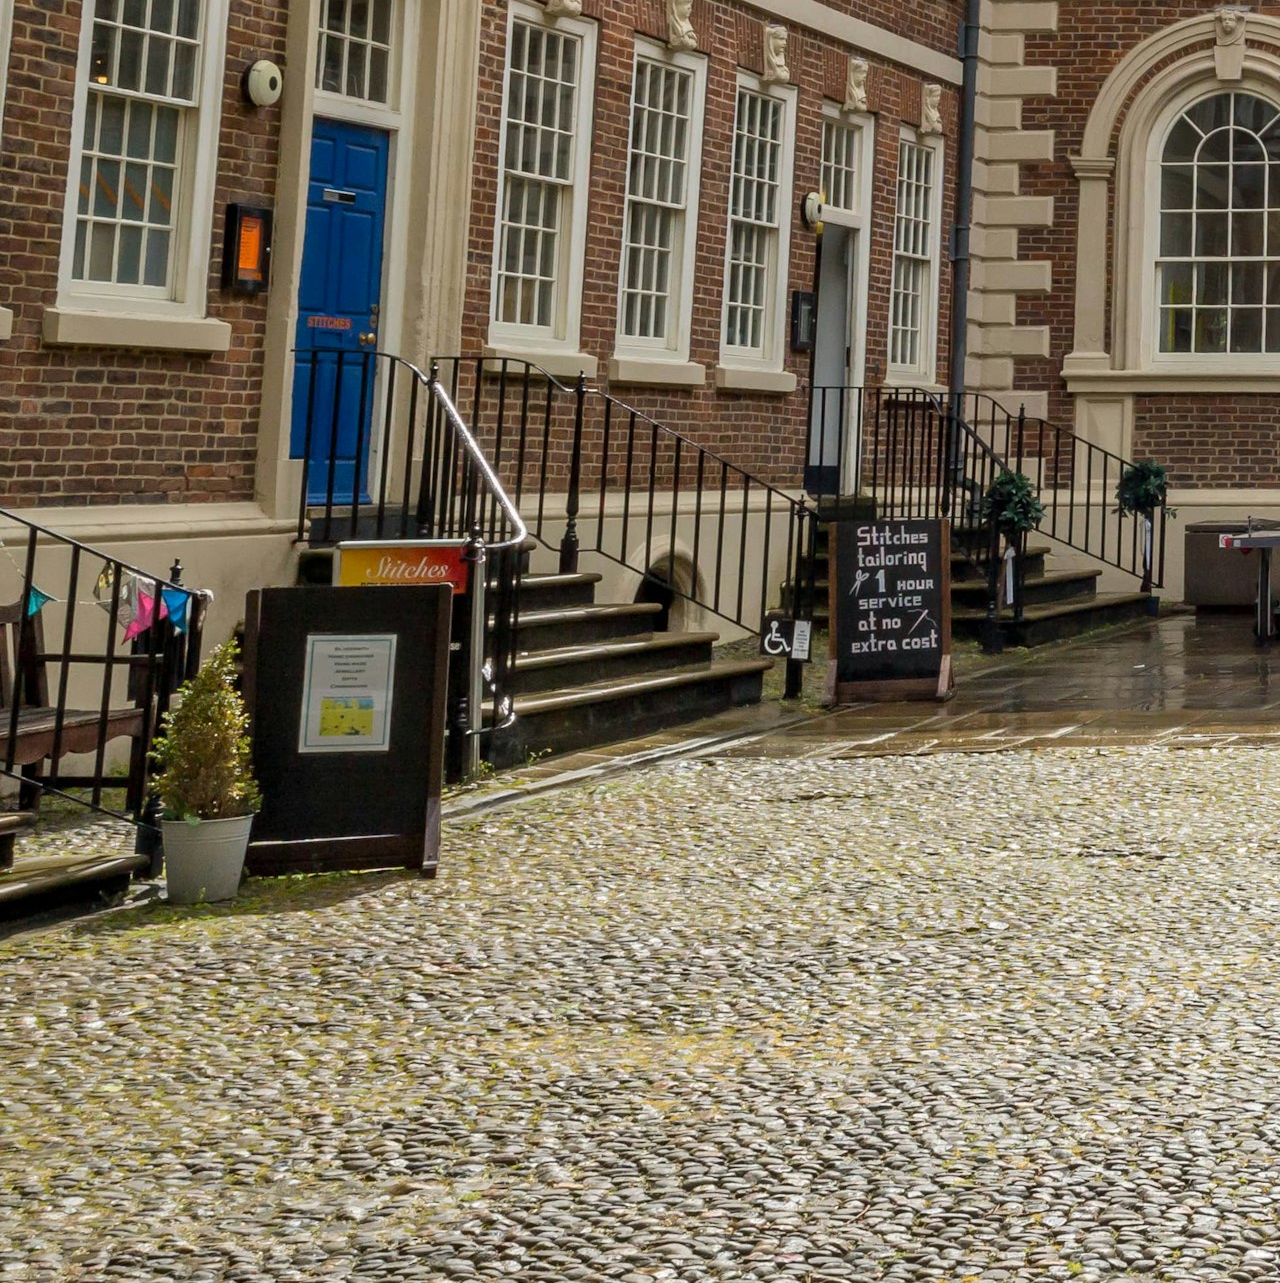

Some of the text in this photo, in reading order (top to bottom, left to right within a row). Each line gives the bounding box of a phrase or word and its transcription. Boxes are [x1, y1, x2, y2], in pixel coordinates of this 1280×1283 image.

[857, 525, 929, 546] Stitches
[366, 556, 450, 579] Stitches
[858, 546, 927, 572] tailoring
[875, 569, 934, 593] 1 HOUR
[858, 593, 922, 610] service
[858, 611, 902, 632] at no
[851, 629, 938, 654] extra cost
